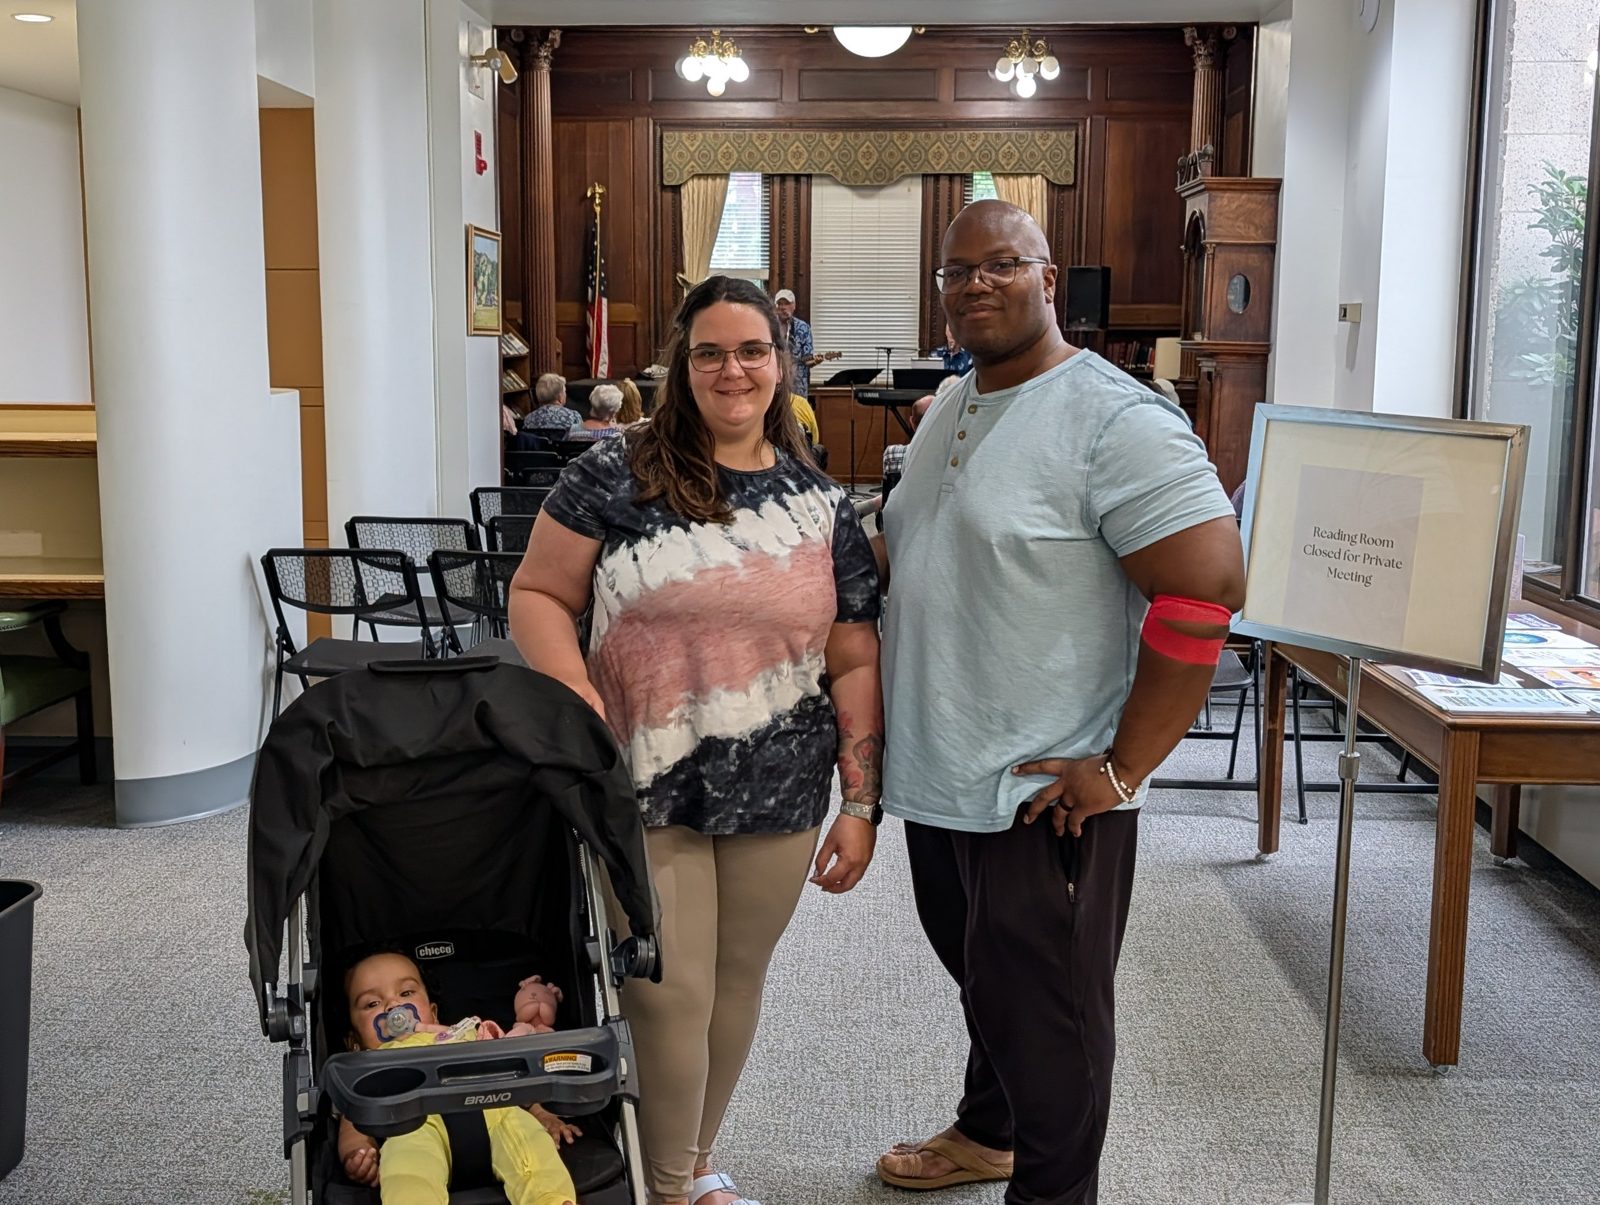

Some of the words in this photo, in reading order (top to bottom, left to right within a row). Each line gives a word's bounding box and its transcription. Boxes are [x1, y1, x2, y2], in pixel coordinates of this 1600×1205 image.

[1313, 526, 1358, 546] Reading
[1359, 533, 1394, 548] Room
[1303, 544, 1341, 560] Closed
[1343, 549, 1361, 562] for
[1363, 553, 1403, 569] Private
[1327, 566, 1373, 587] Meeting
[420, 946, 451, 956] chicco
[548, 1055, 577, 1063] WARNING
[464, 1092, 512, 1105] BRAVO
